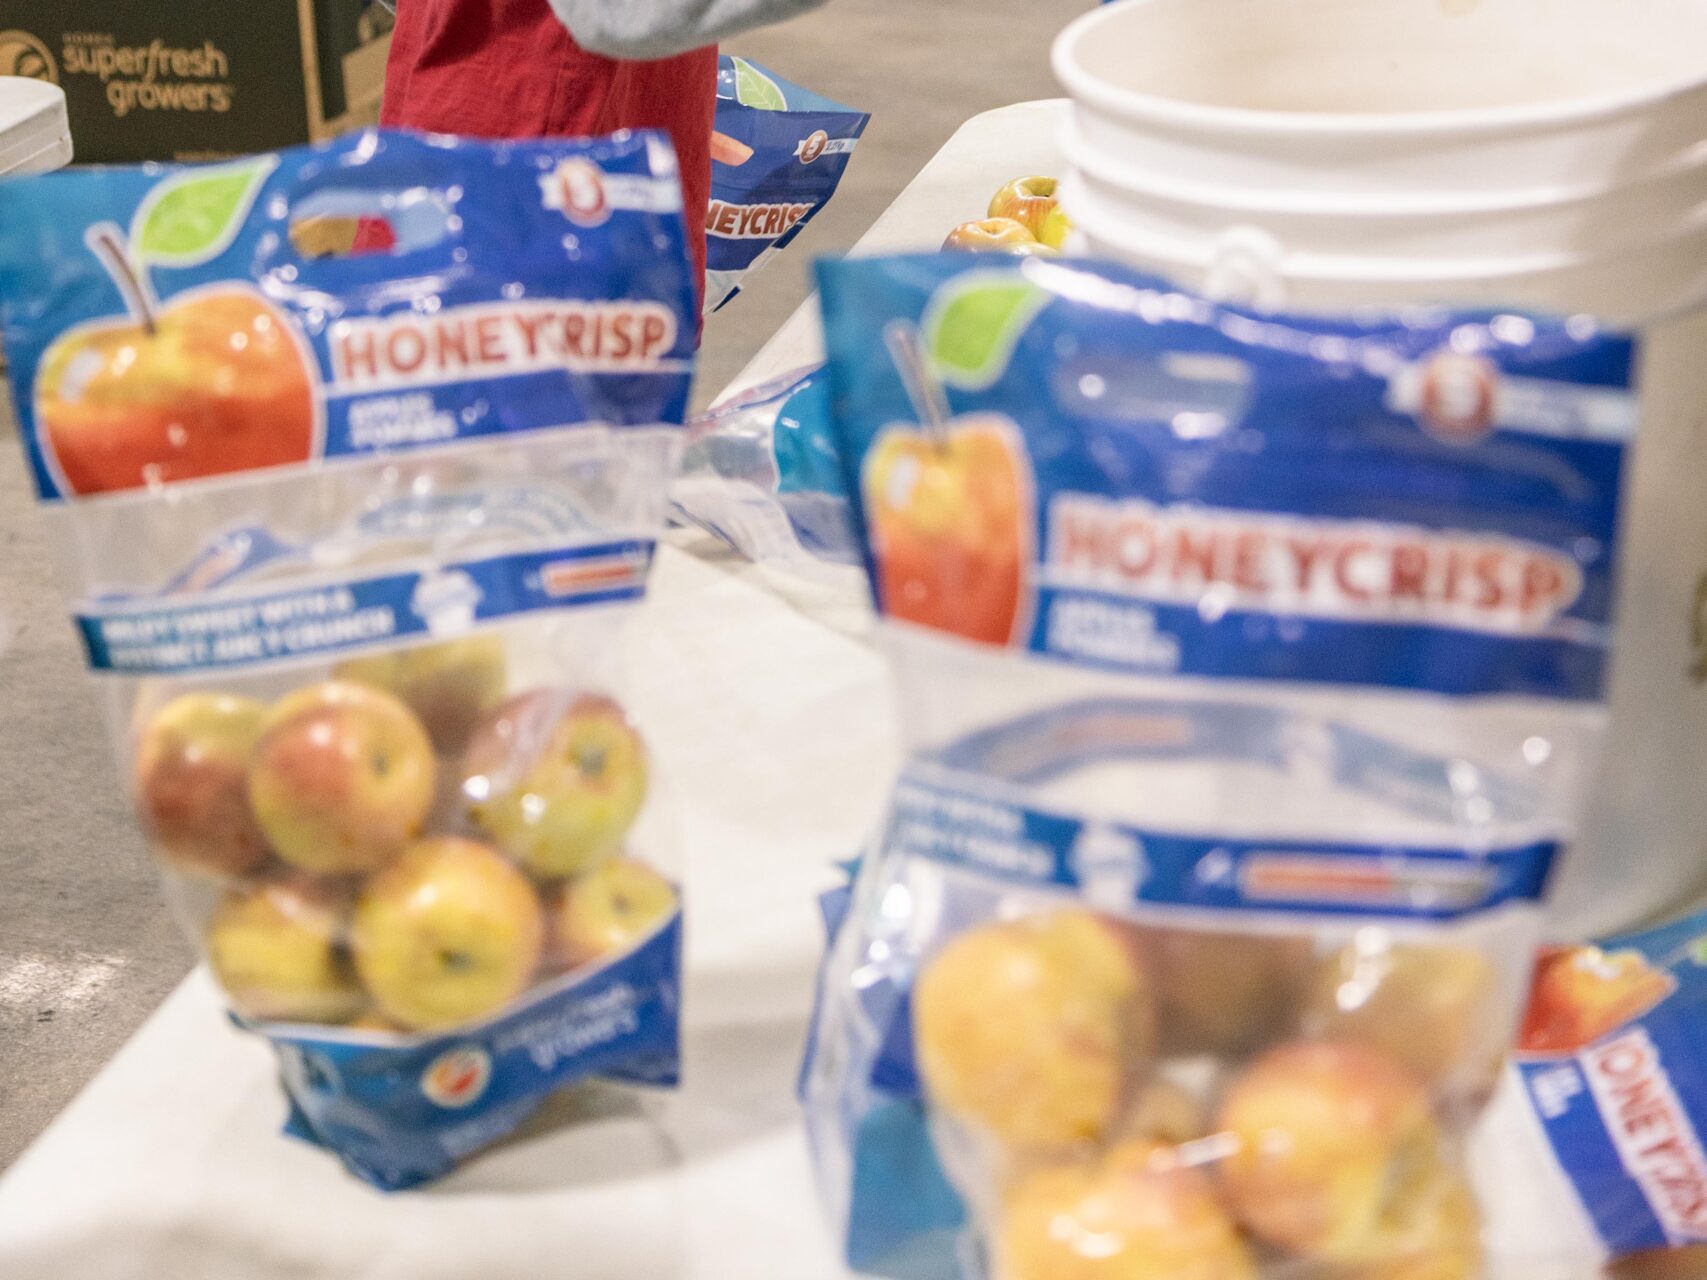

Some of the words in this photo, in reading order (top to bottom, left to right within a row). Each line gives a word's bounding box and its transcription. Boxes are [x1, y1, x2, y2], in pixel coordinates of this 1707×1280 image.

[62, 38, 229, 84] superfresh
[106, 80, 232, 118] growers
[705, 202, 809, 235] NEYCRIS
[339, 312, 667, 380] HONEYRISP
[1058, 508, 1564, 615] HONEYCRISP
